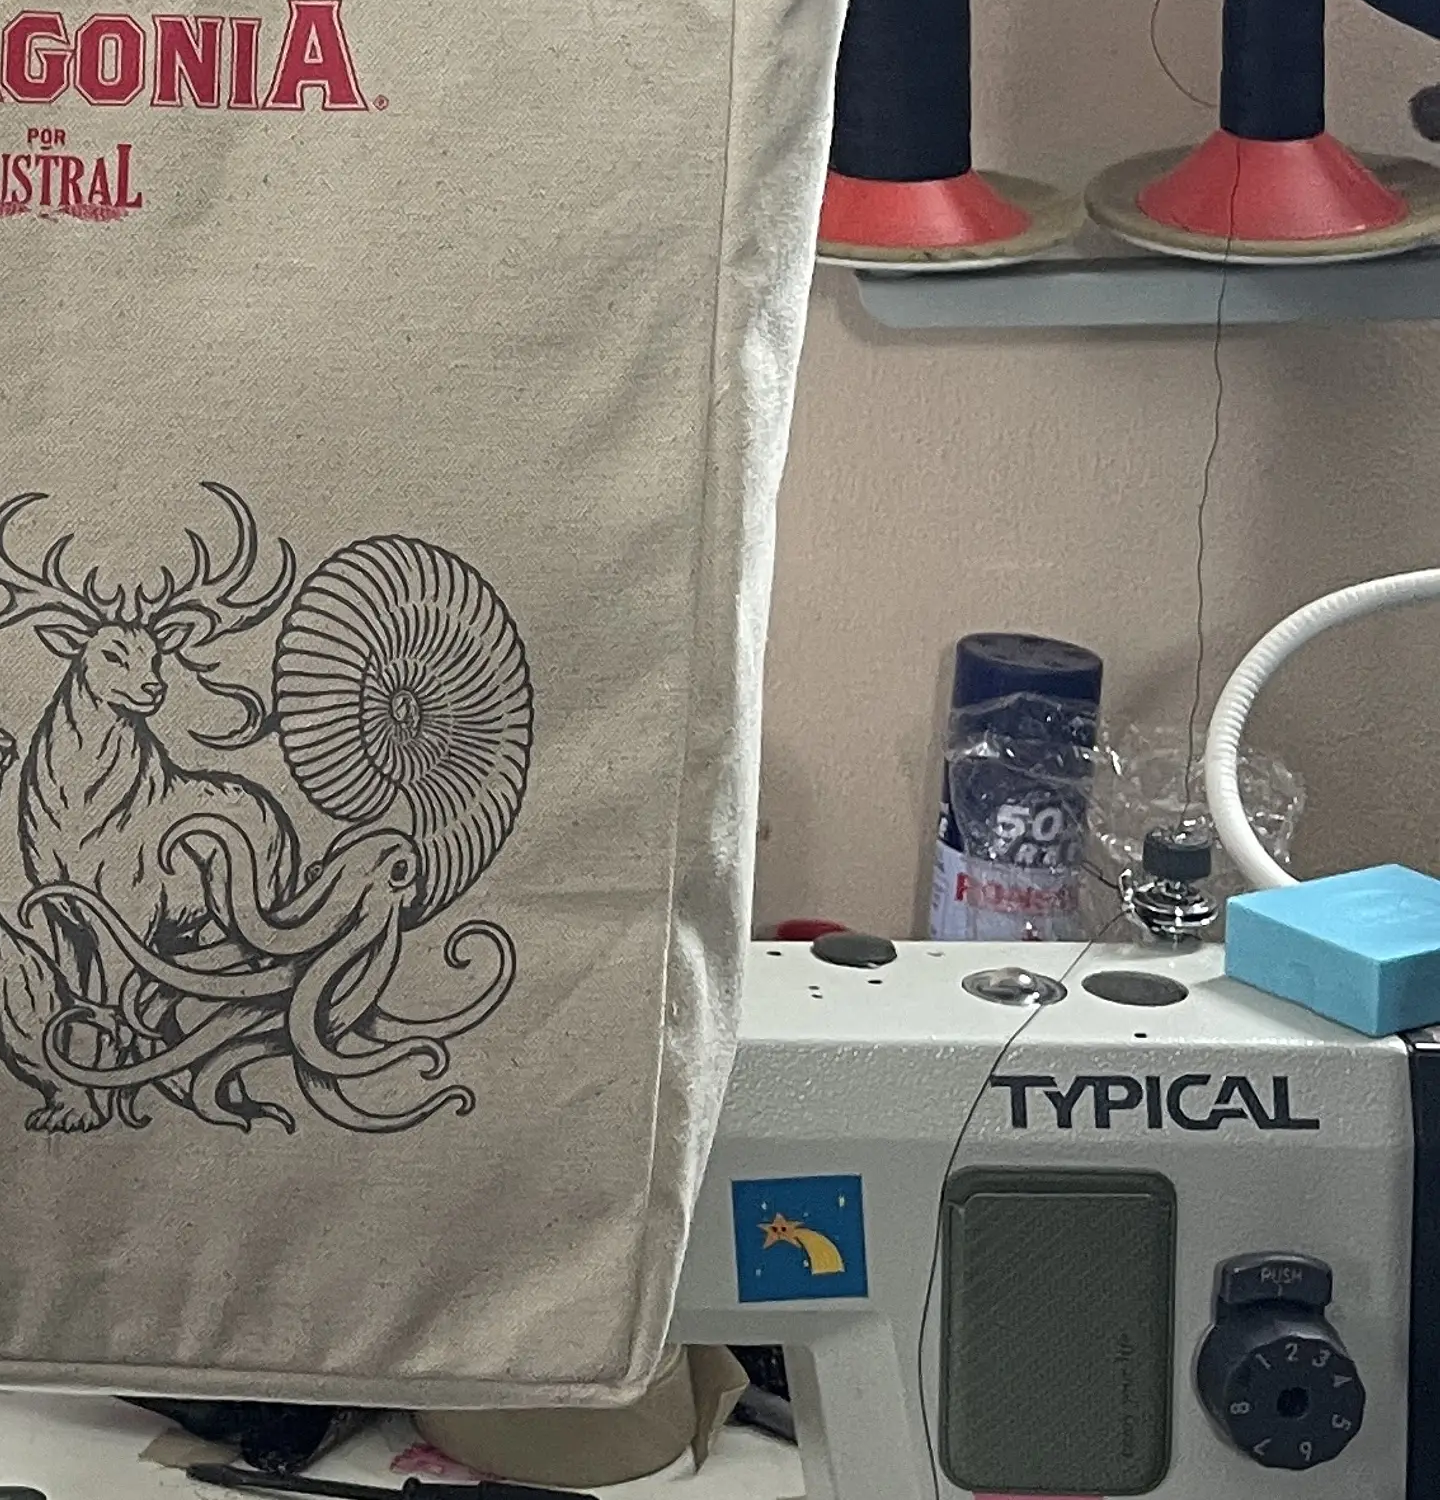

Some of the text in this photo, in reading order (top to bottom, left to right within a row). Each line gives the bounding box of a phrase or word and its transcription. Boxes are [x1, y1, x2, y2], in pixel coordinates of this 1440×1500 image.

[26, 127, 67, 150] POR
[990, 1074, 1320, 1130] TYPICAL
[1260, 1266, 1304, 1284] PUSH
[1285, 1343, 1300, 1362] 2
[1312, 1350, 1331, 1368] 3
[1256, 1353, 1272, 1371] 1
[1229, 1400, 1251, 1415] 8
[1331, 1413, 1353, 1431] 5
[1299, 1440, 1313, 1461] 6
